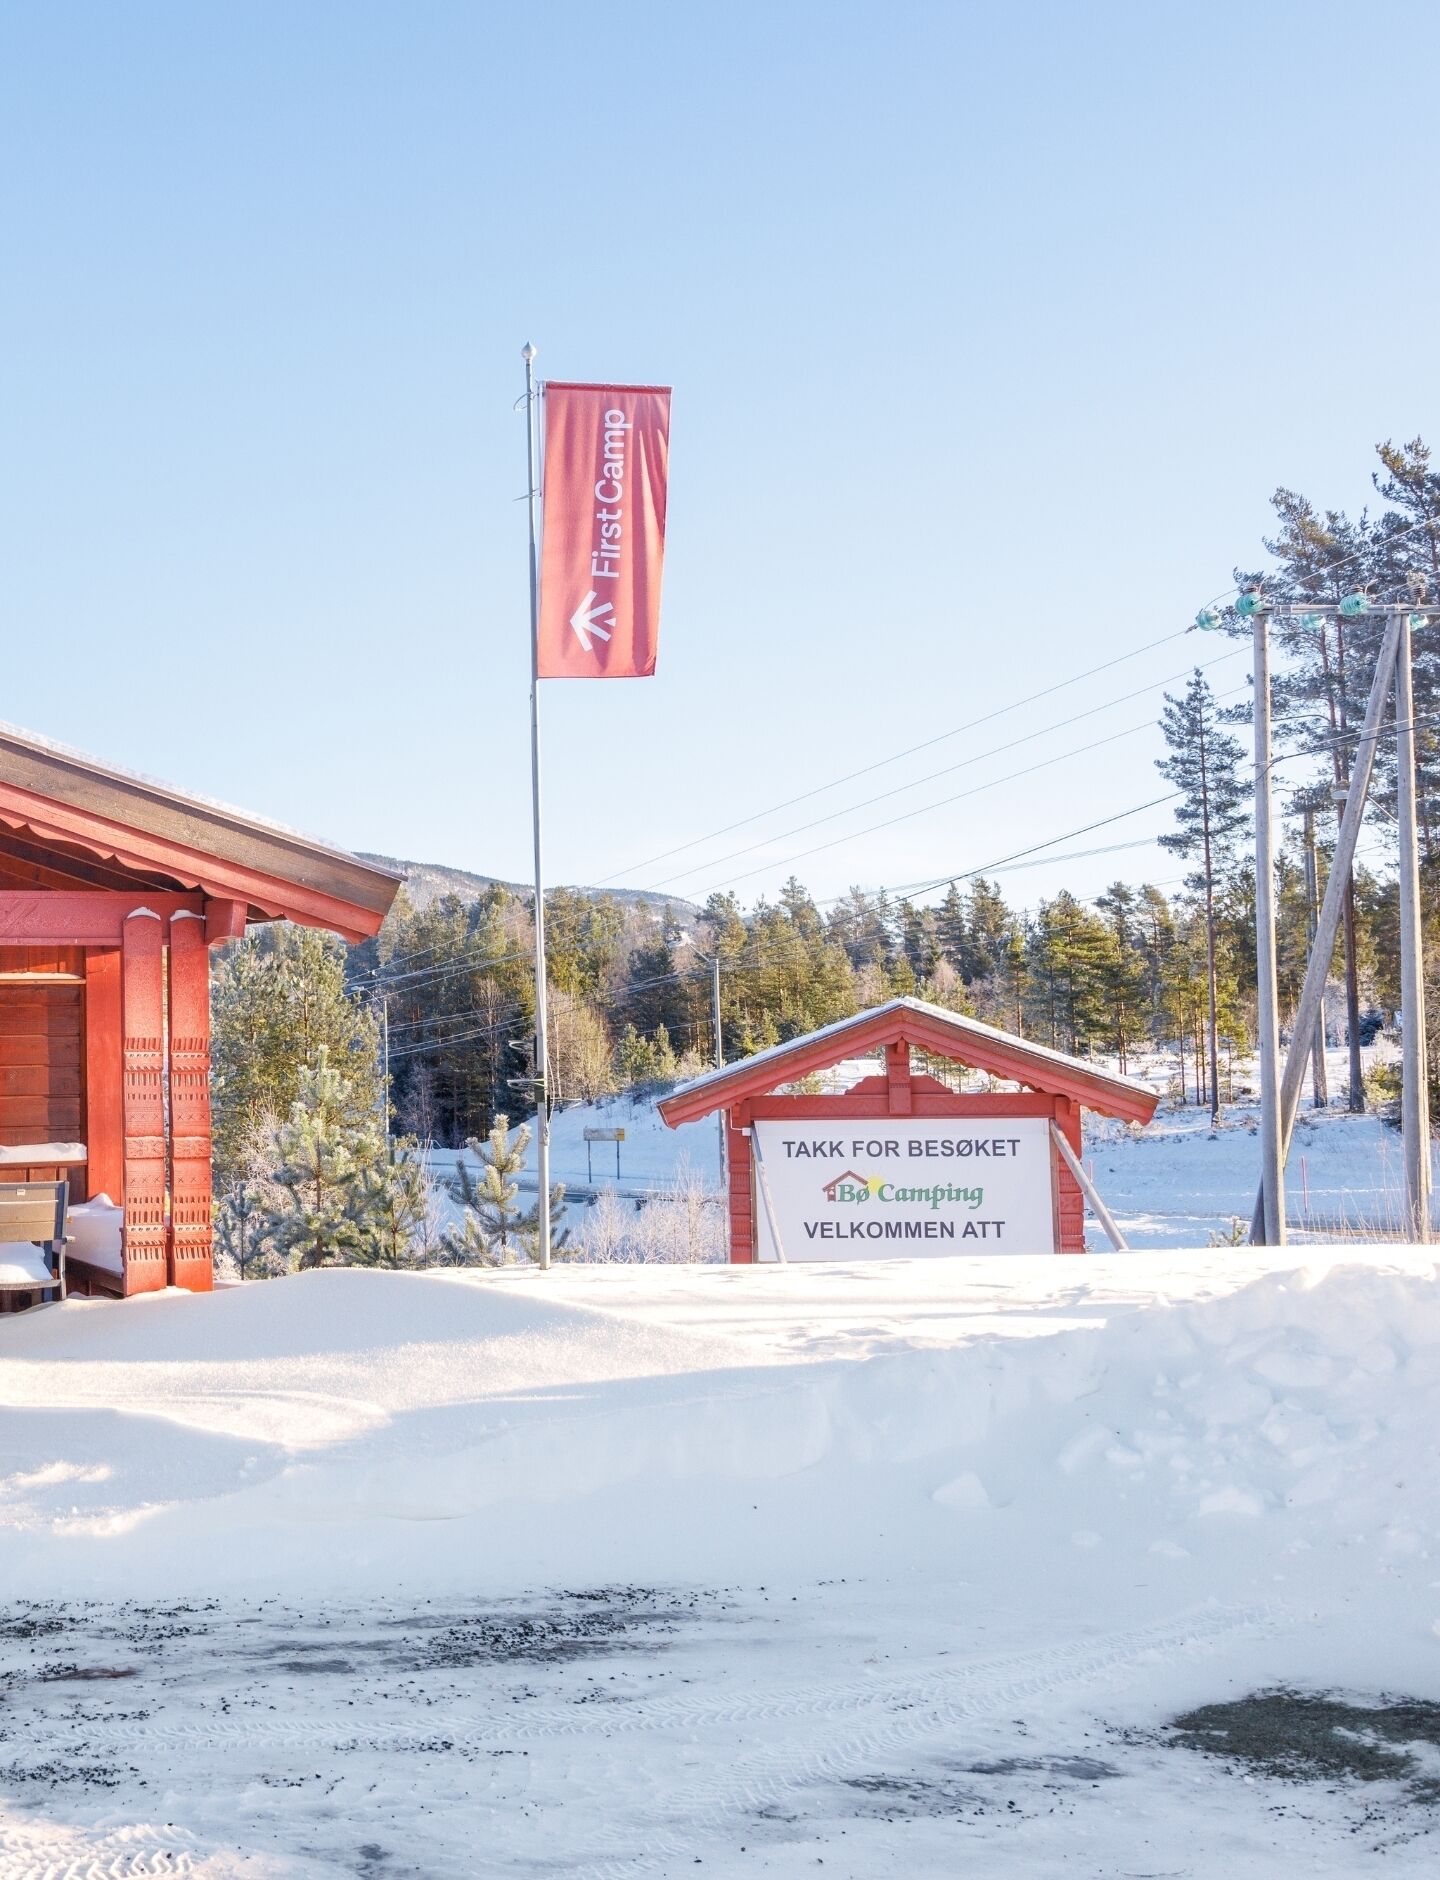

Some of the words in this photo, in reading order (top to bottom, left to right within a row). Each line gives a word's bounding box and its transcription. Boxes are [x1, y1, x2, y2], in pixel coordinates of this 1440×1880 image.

[594, 409, 633, 504] Camp
[591, 508, 622, 578] First
[782, 1141, 844, 1158] TAKK
[852, 1140, 900, 1158] FOR
[908, 1139, 1021, 1157] BESØKET
[838, 1184, 869, 1205] Bø
[878, 1183, 984, 1209] Camping
[804, 1221, 955, 1239] VELKOMMEN
[962, 1221, 1006, 1239] ATT
